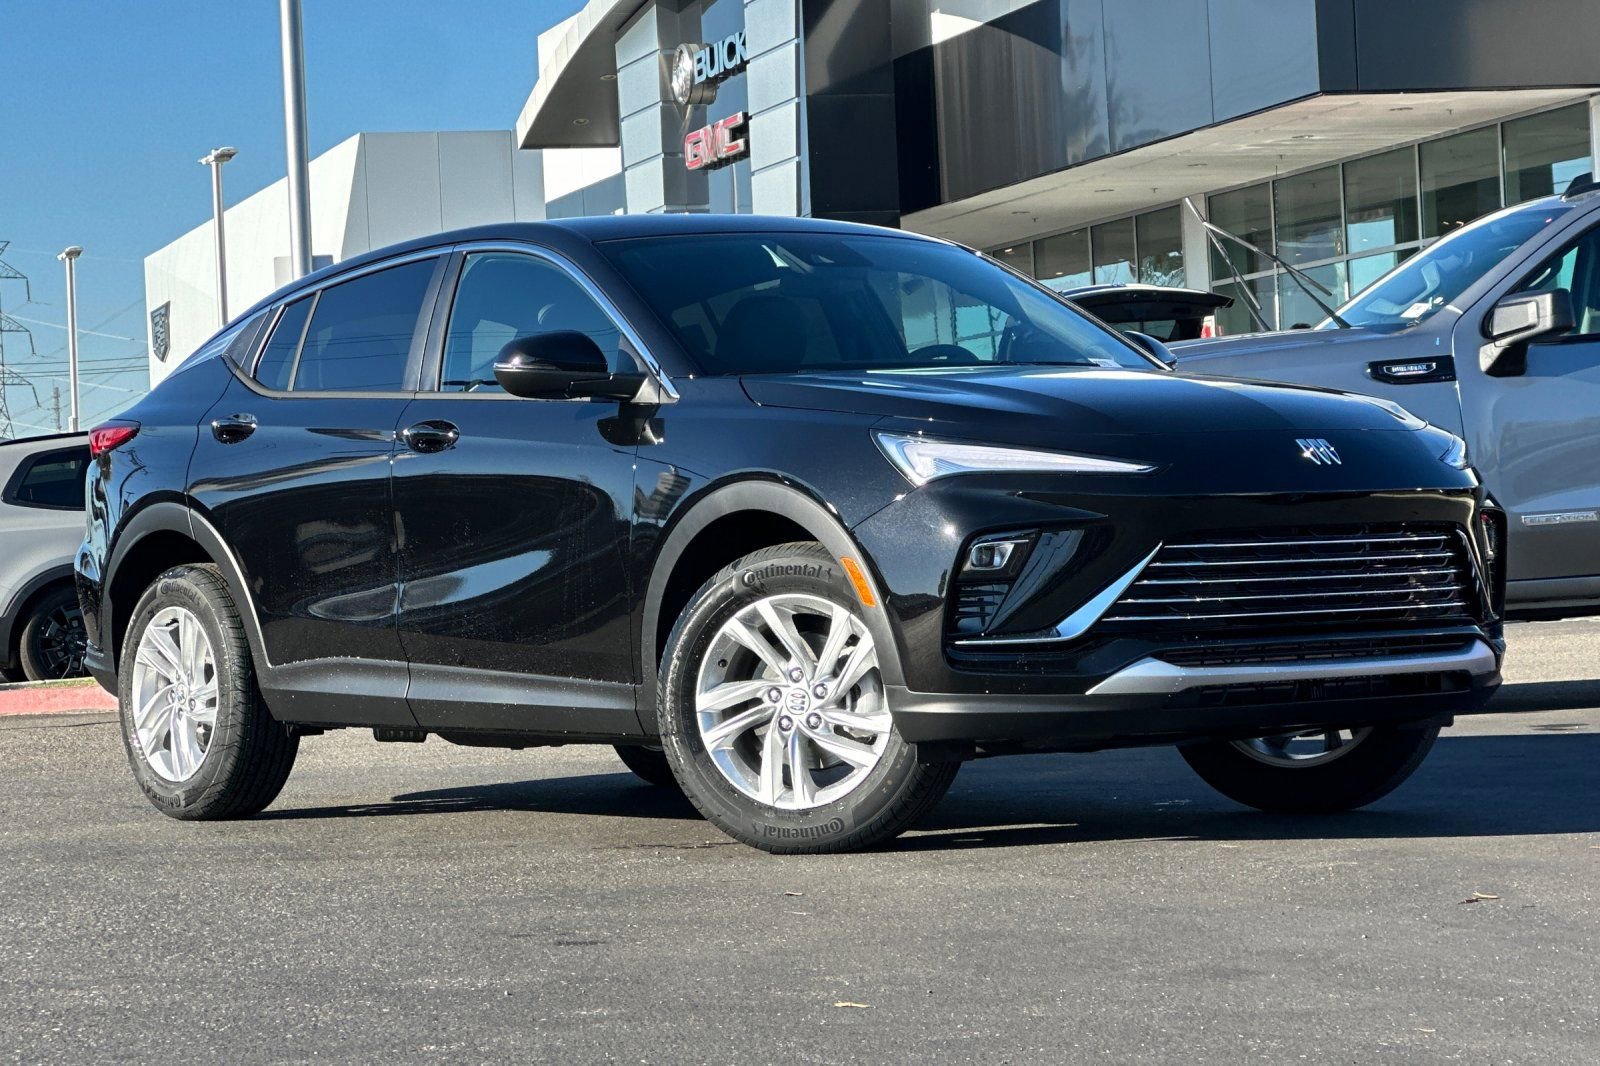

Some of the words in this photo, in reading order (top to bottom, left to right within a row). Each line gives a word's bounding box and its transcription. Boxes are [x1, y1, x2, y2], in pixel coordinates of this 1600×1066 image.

[694, 30, 747, 84] BUICK
[685, 111, 745, 170] GMC
[742, 564, 822, 587] Continental
[763, 817, 845, 839] Continental
